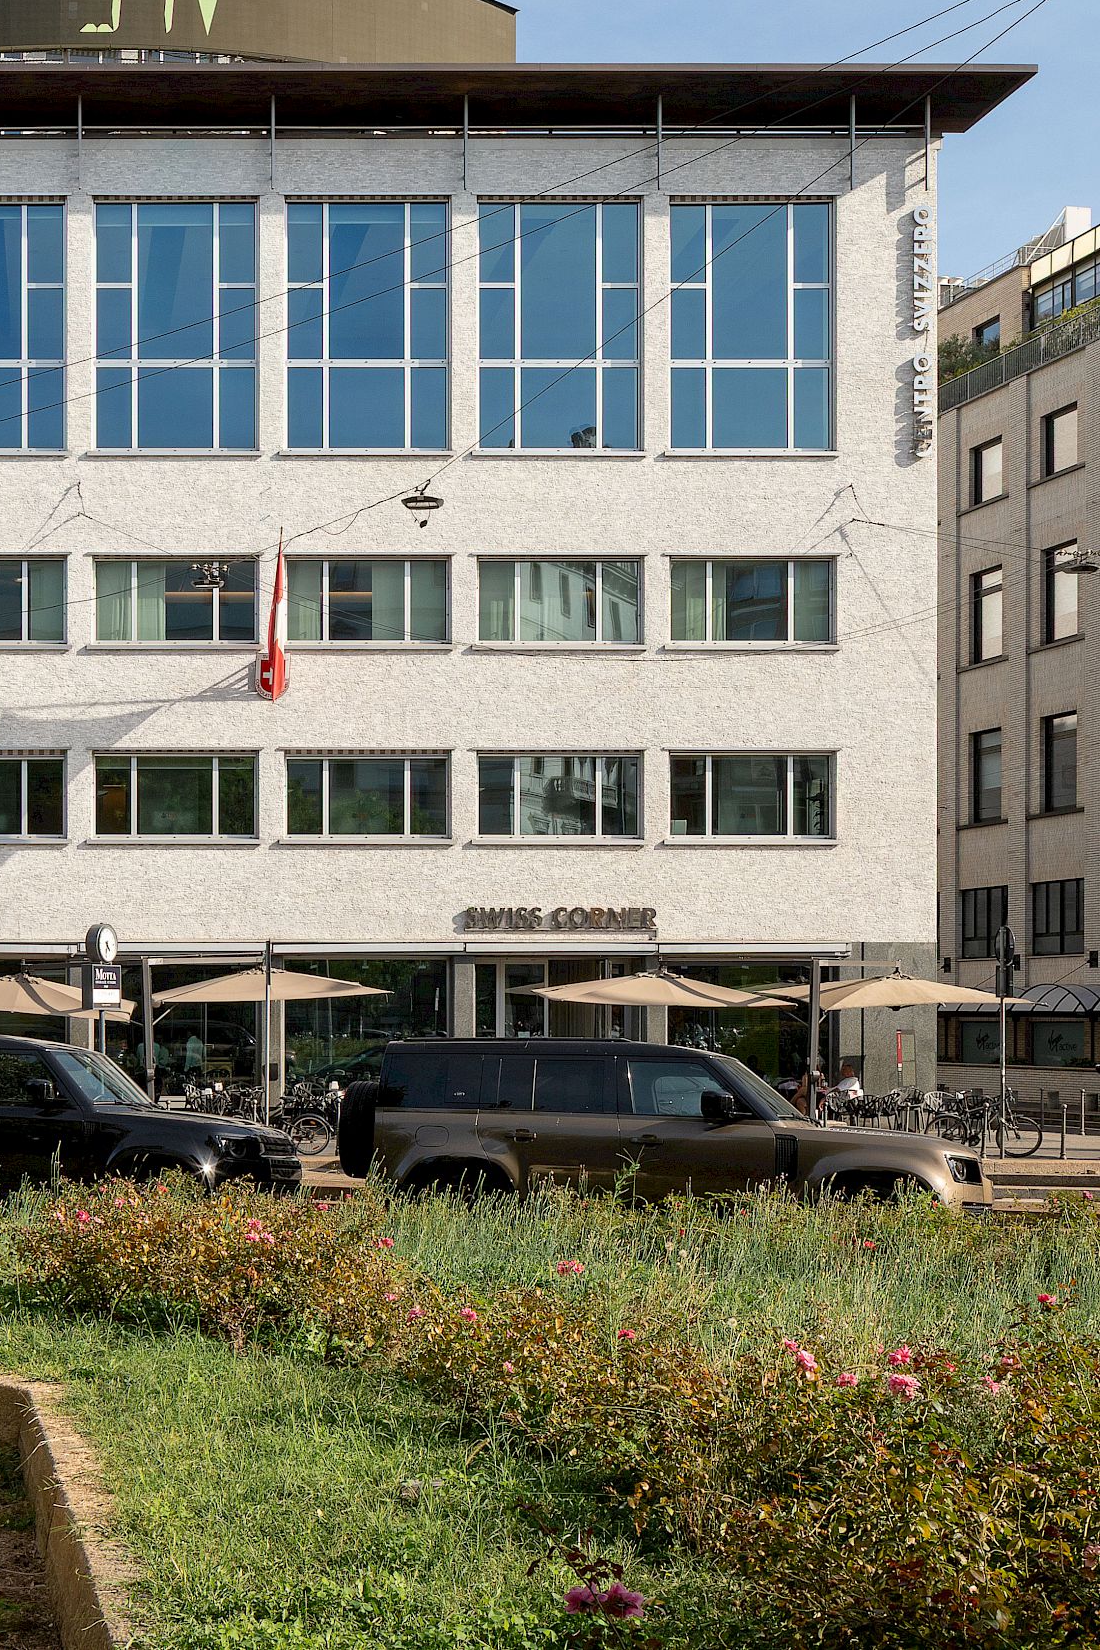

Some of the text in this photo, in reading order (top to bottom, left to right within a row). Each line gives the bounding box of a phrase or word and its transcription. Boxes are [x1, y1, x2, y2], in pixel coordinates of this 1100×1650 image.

[913, 205, 933, 458] CENTRO SVIZZERO
[465, 907, 657, 928] SWISS CORNER
